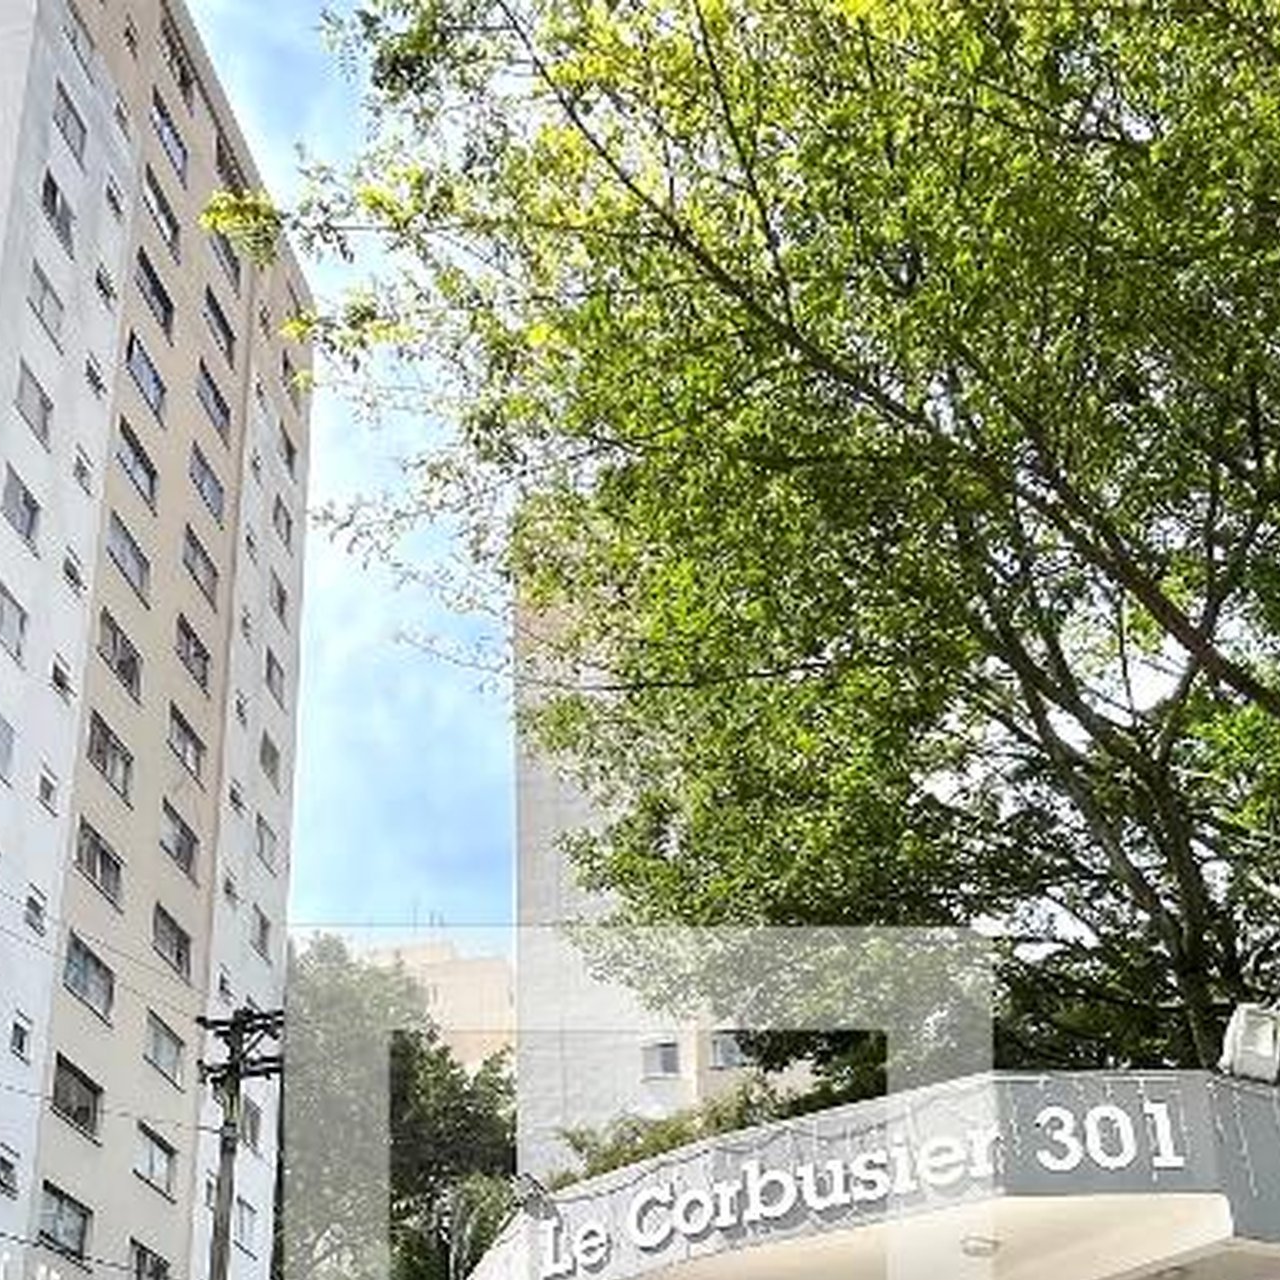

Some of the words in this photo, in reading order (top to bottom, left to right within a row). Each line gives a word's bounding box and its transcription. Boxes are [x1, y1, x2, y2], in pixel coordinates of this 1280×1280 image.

[539, 1216, 610, 1272] Le
[629, 1122, 1000, 1251] Corbusier
[1035, 1100, 1184, 1172] 301
